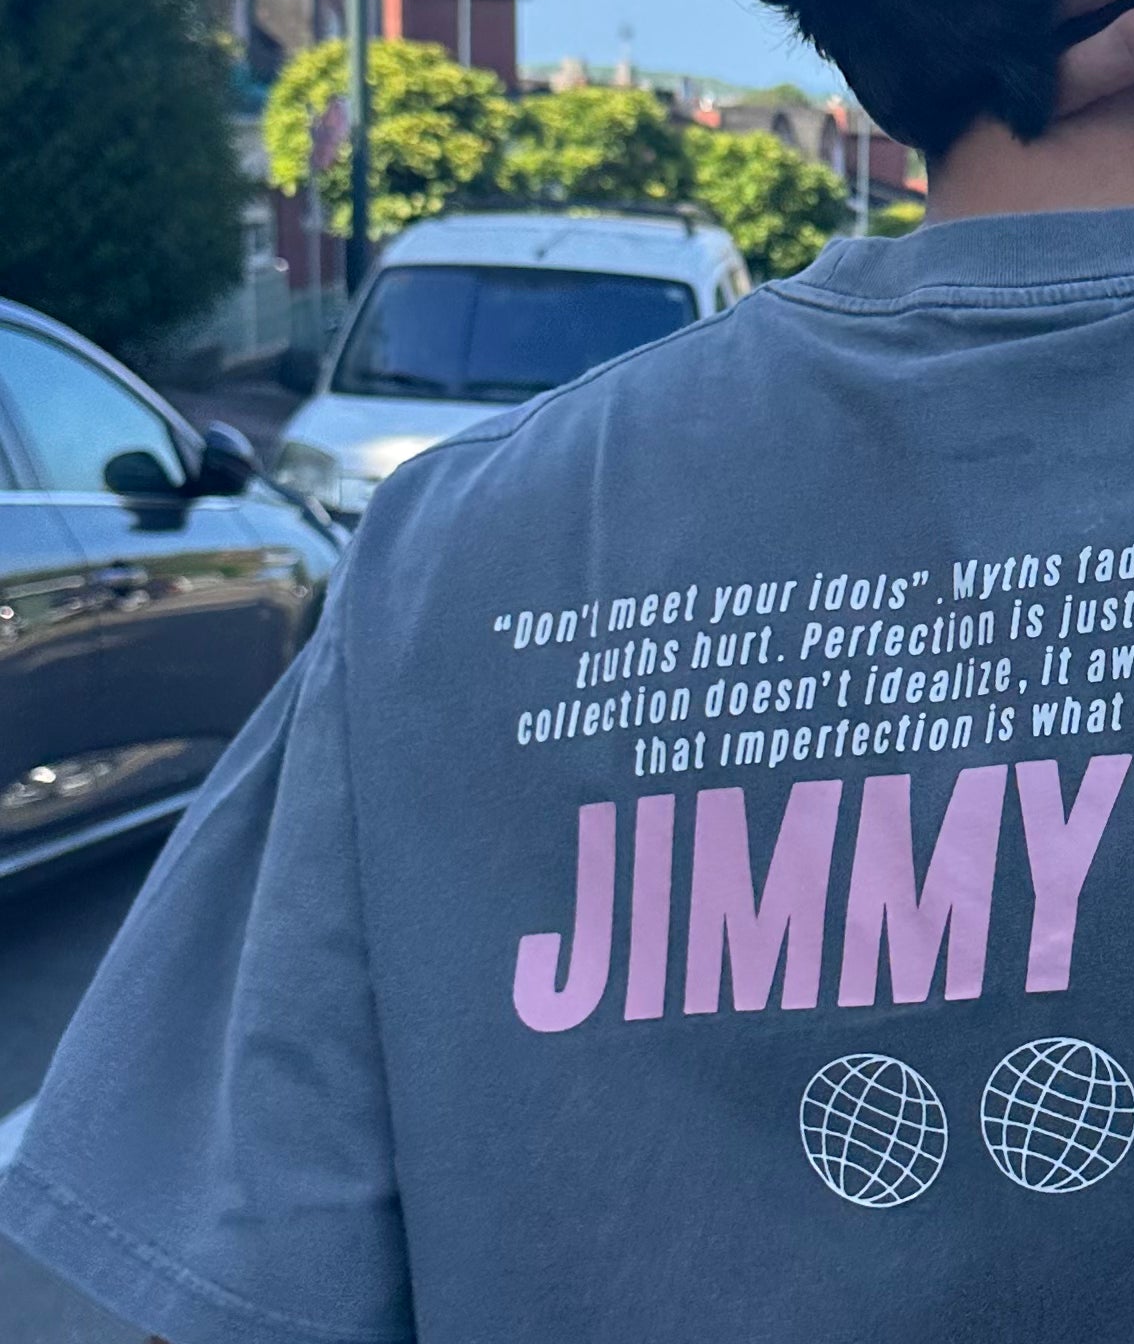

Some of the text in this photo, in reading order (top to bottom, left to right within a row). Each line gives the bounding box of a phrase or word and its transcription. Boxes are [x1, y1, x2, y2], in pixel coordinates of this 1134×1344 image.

[607, 584, 698, 632] meet
[709, 581, 798, 624] your
[952, 553, 1063, 601] Myths
[575, 638, 680, 689] truths
[690, 626, 785, 670] hurt.
[799, 611, 996, 661] Perfection
[1009, 598, 1045, 641] is
[517, 685, 691, 746] collection
[863, 656, 1028, 708] idealize,
[1040, 644, 1073, 686] it
[634, 731, 706, 777] that
[719, 712, 973, 769] imperfection
[984, 702, 1016, 745] is
[1032, 690, 1125, 737] what
[512, 753, 1132, 1034] JIMMY
